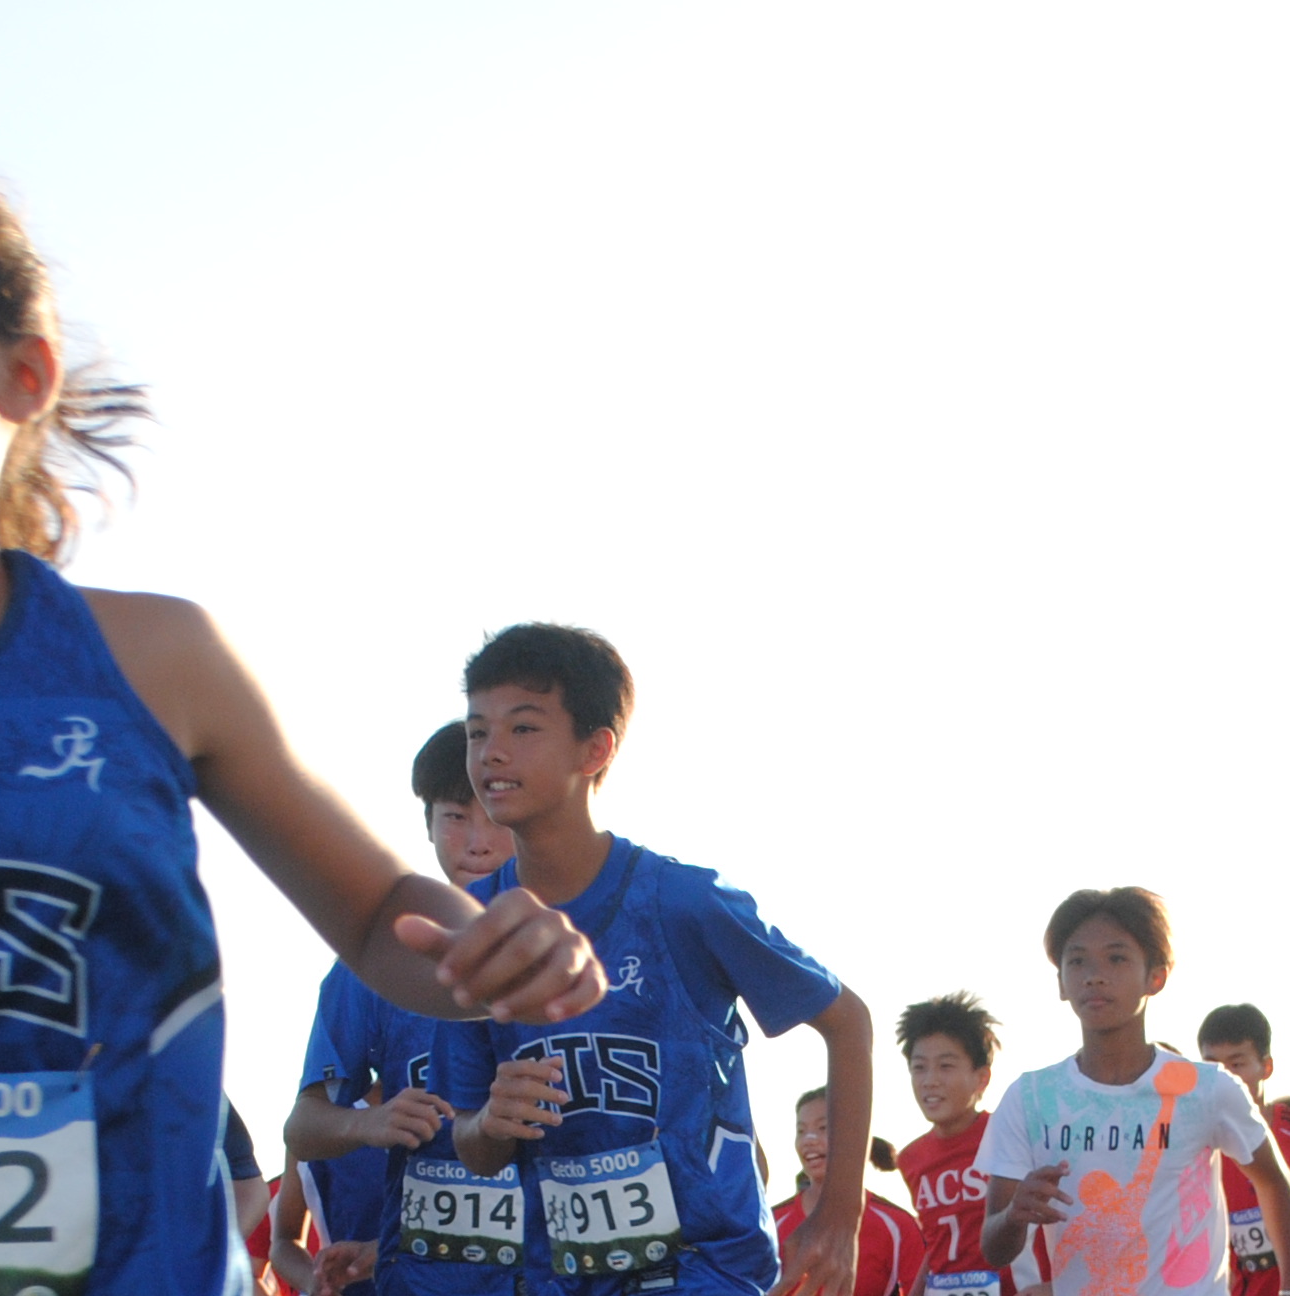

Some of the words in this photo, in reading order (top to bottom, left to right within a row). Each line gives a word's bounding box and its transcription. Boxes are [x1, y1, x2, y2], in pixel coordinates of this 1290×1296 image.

[512, 1032, 661, 1125] IS
[1043, 1122, 1171, 1151] JORDAN
[415, 1161, 467, 1180] Gecko
[550, 1159, 587, 1179] Gecko
[590, 1150, 641, 1177] 5000
[915, 1165, 992, 1210] ACS
[433, 1189, 517, 1231] 914
[570, 1181, 656, 1235] 913
[961, 1272, 989, 1286] 5000
